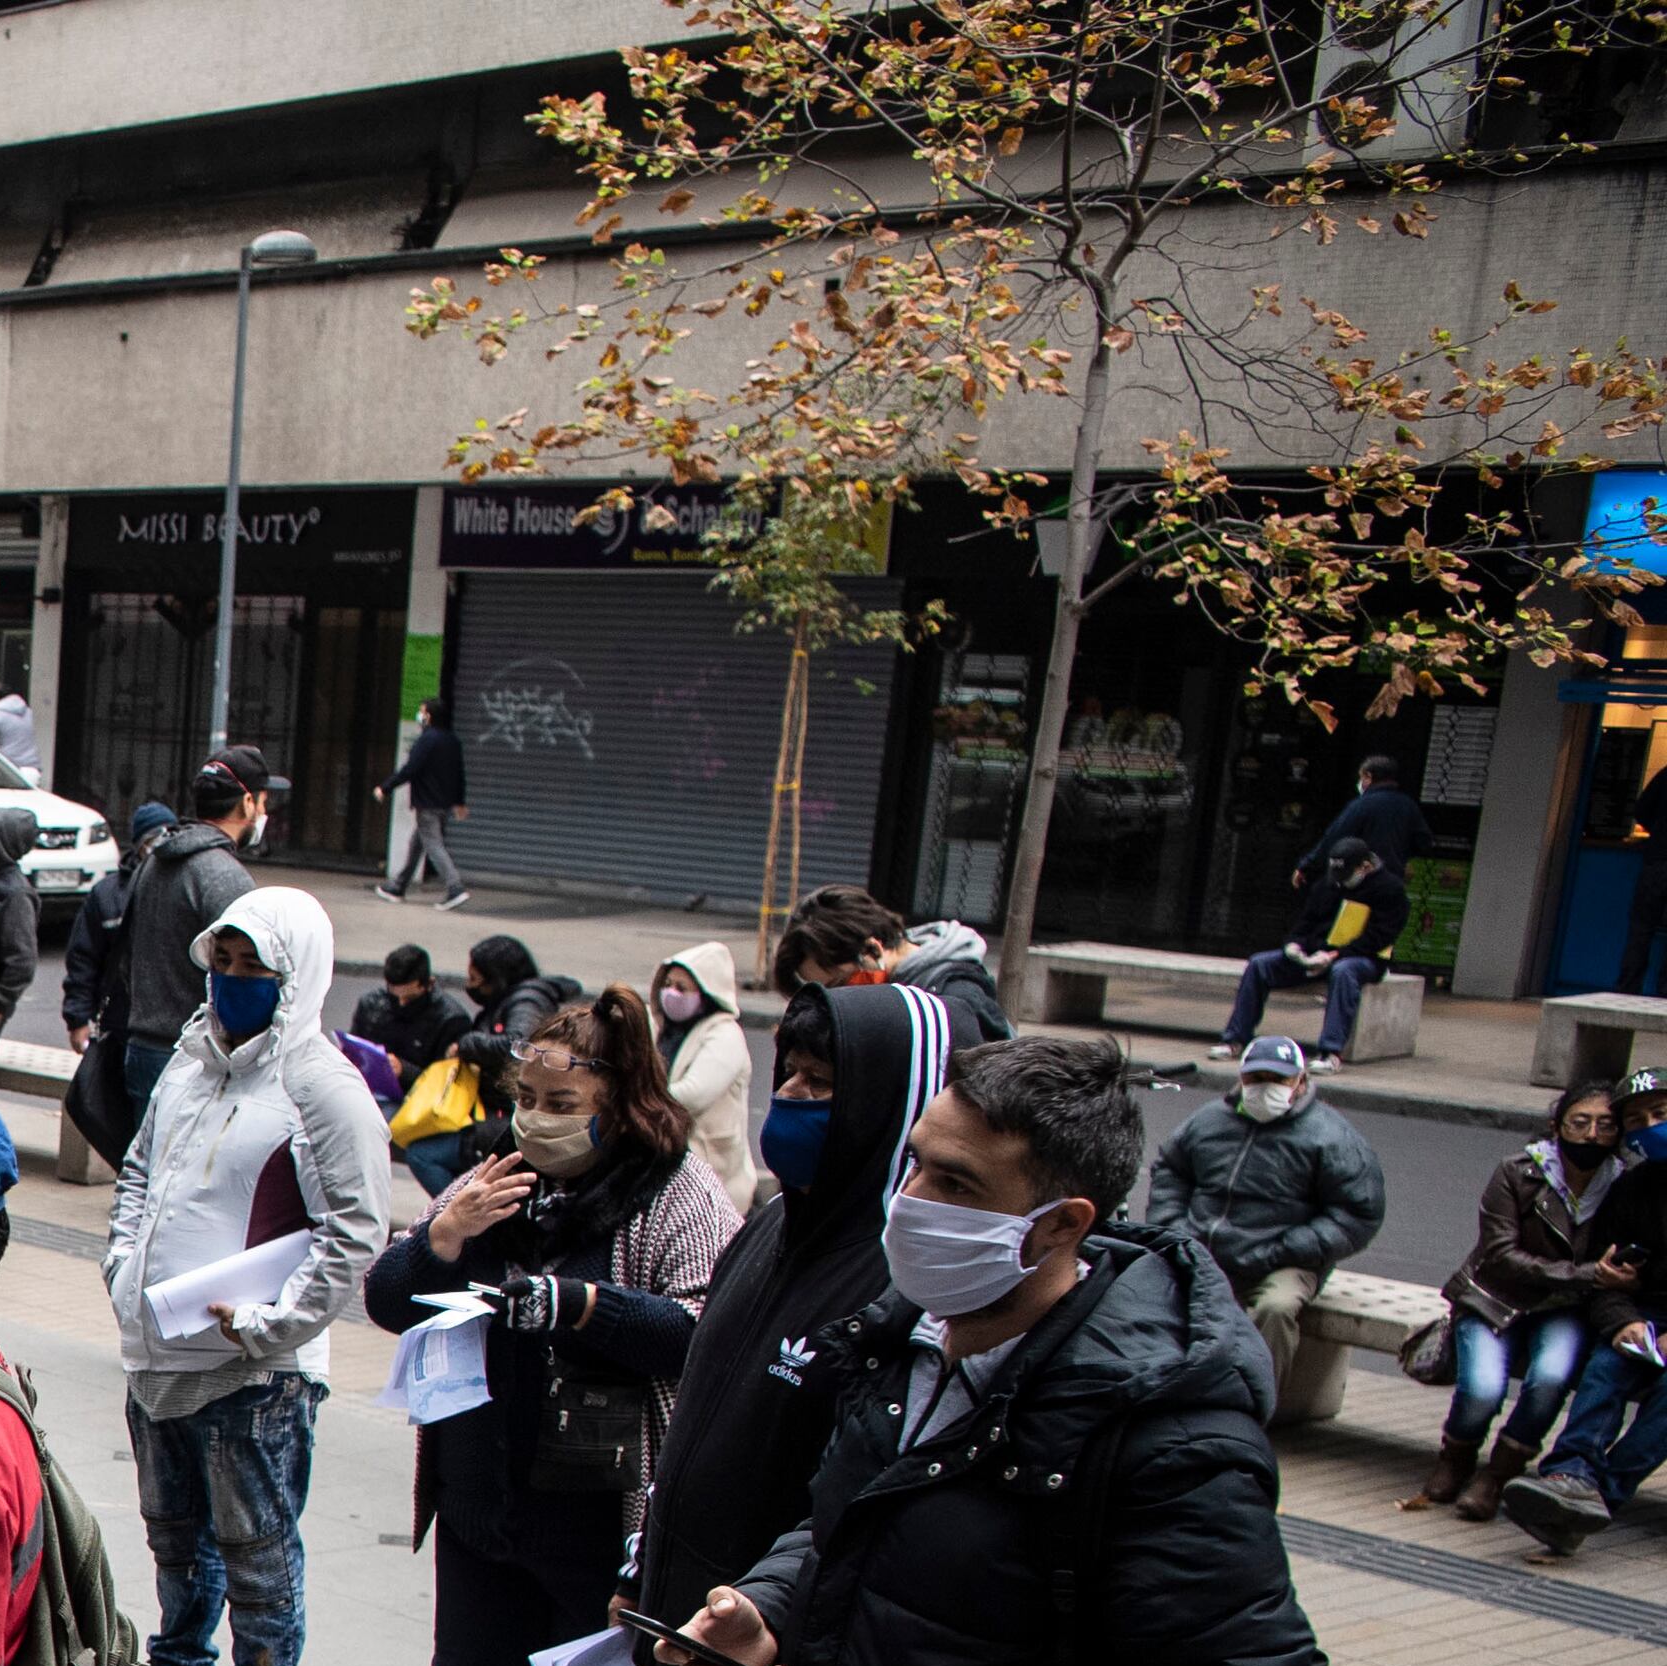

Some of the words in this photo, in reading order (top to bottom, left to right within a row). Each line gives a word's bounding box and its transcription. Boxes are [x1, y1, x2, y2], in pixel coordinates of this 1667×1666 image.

[118, 513, 187, 543] MISSI
[453, 496, 509, 535] White
[768, 1364, 803, 1387] adidas
